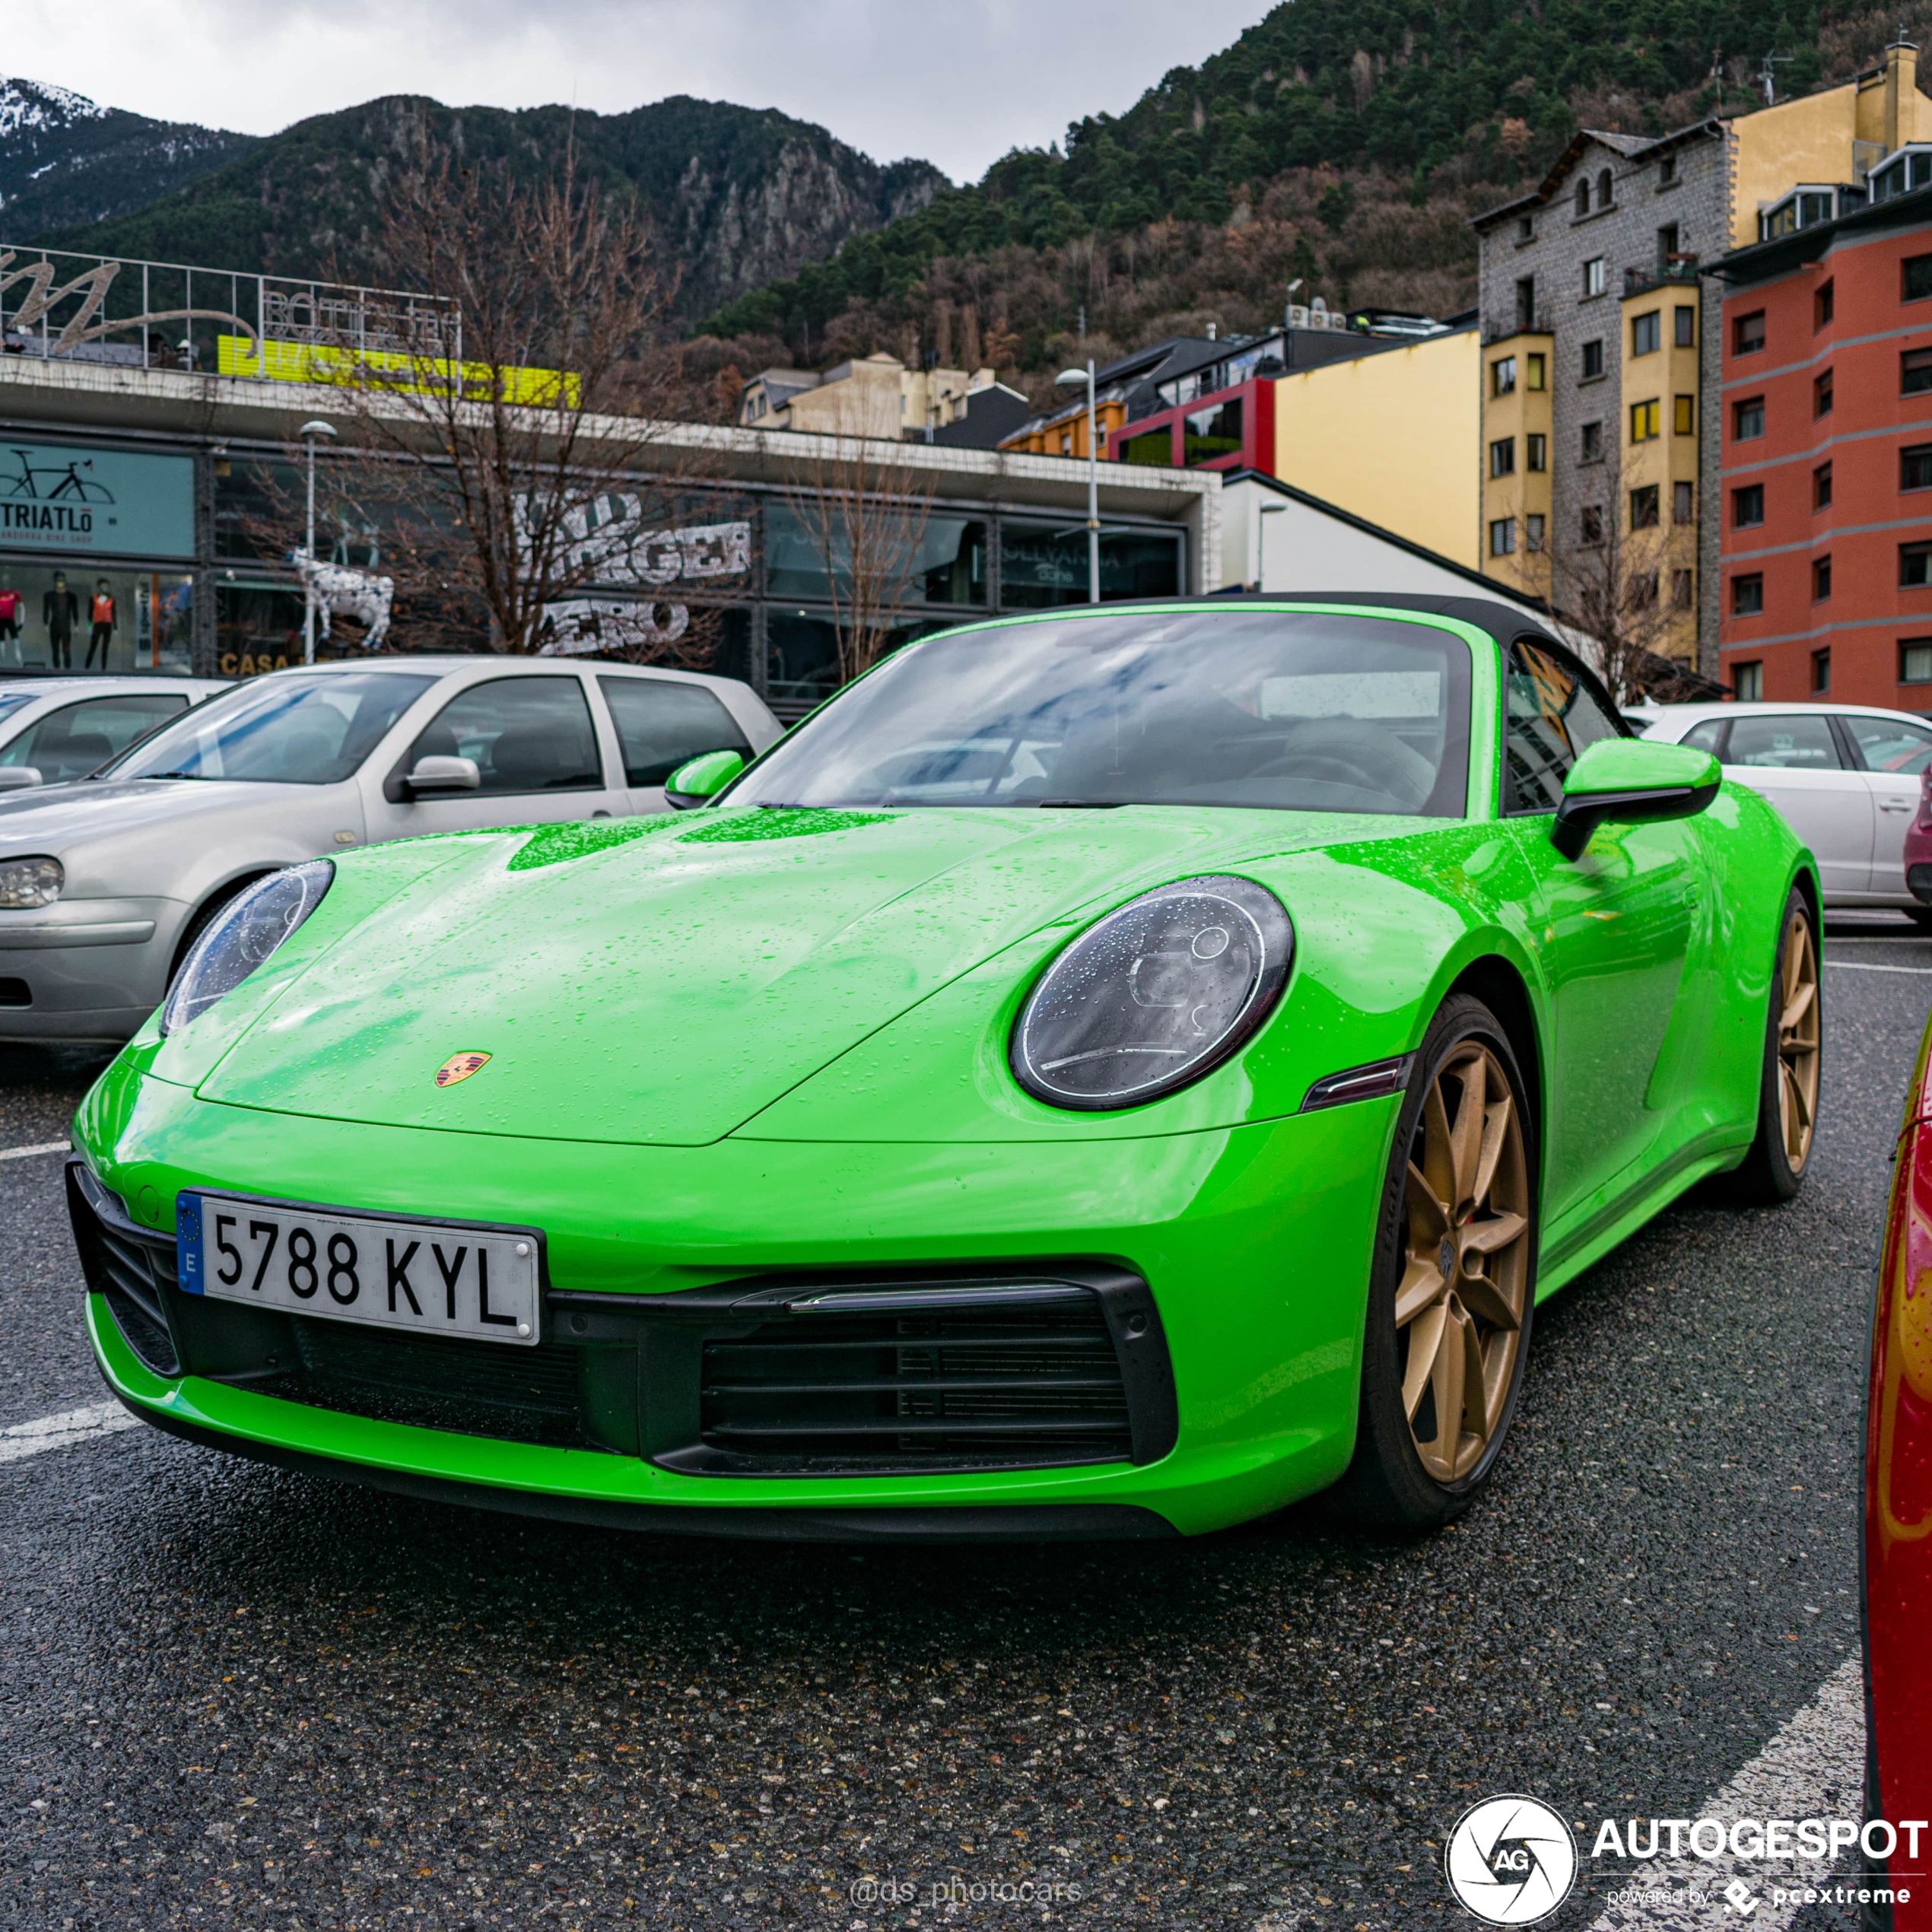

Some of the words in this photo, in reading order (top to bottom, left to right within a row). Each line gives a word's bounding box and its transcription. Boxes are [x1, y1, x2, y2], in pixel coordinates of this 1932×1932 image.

[46, 532, 65, 543] BIKE
[69, 534, 93, 544] SHOP
[221, 652, 288, 675] CASA
[186, 1252, 196, 1273] E
[215, 1214, 360, 1306] 5788
[386, 1238, 518, 1327] KYL
